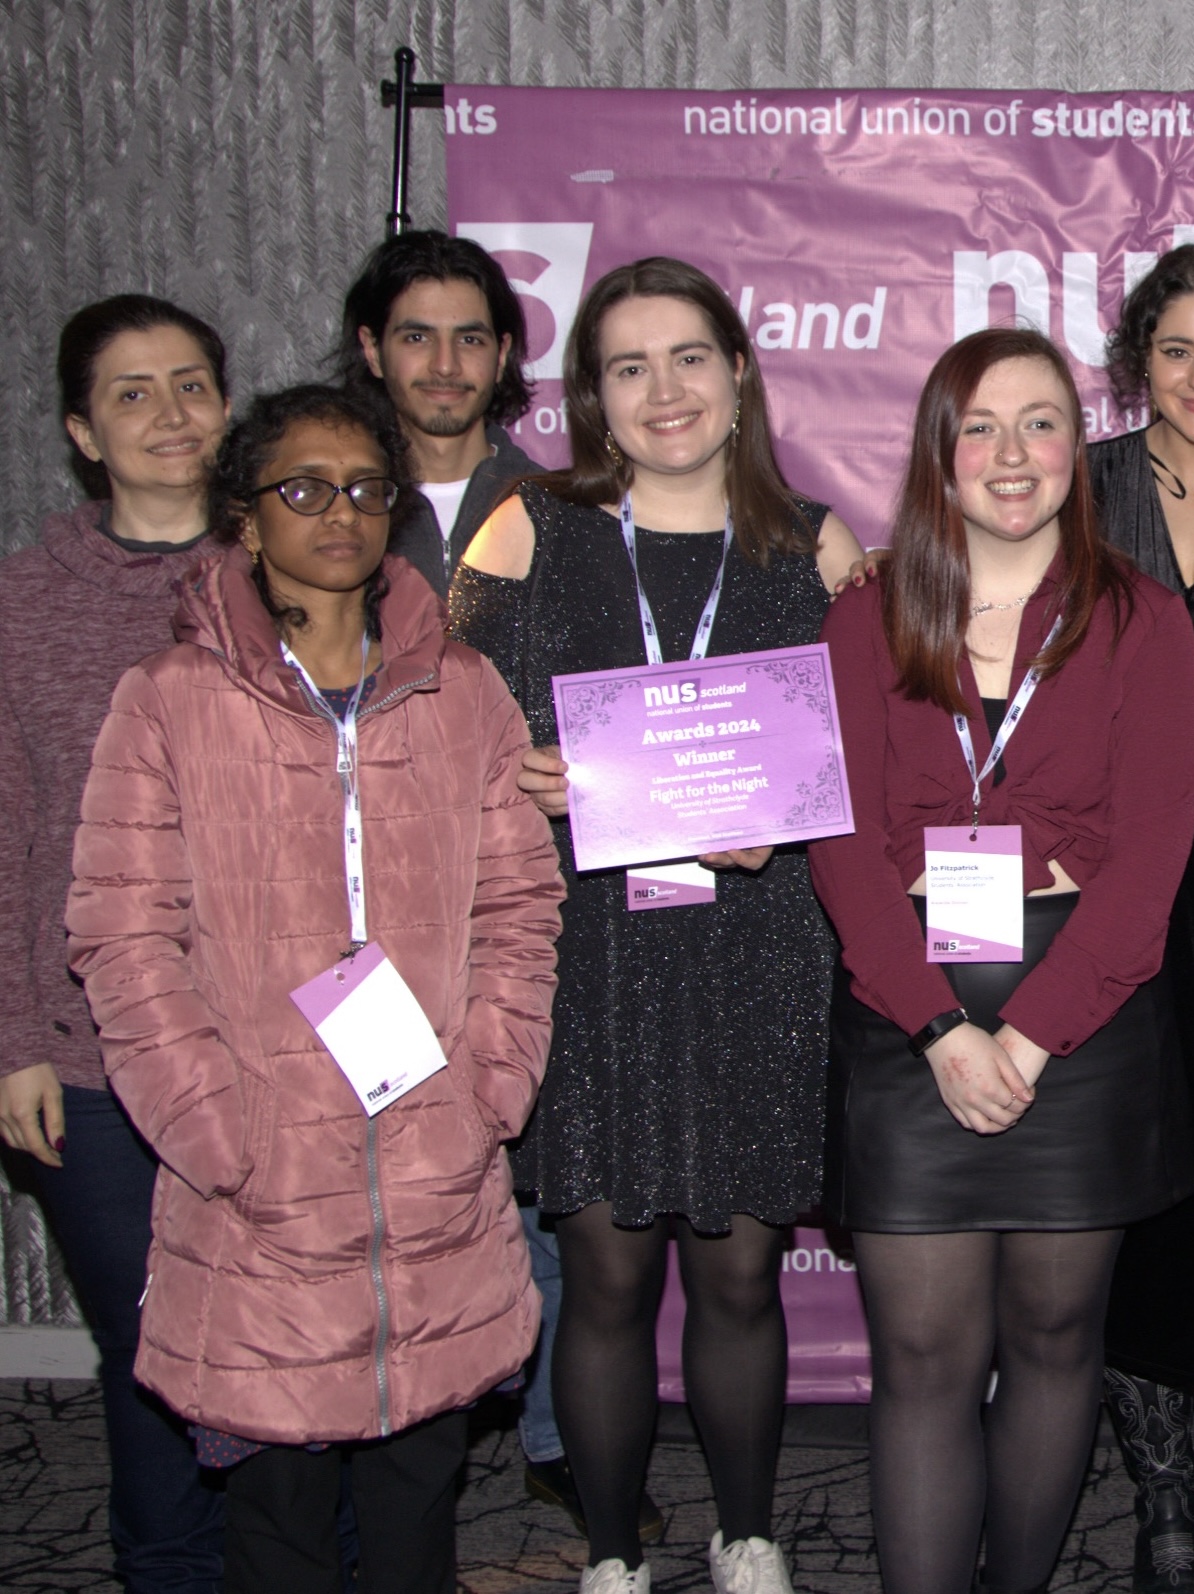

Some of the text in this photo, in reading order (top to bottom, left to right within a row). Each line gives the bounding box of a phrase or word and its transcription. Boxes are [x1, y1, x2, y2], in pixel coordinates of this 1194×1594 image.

[683, 97, 847, 135] national
[860, 98, 970, 136] union
[983, 99, 1023, 136] of
[644, 682, 746, 707] nus scotland
[646, 707, 673, 717] national
[674, 705, 693, 713] union
[701, 701, 733, 710] students
[641, 718, 761, 745] Awards 2024
[672, 749, 736, 767] Winner
[737, 763, 762, 774] Award
[649, 776, 769, 804] Fight for the Night
[634, 889, 656, 899] nus
[933, 942, 957, 951] nus
[366, 1081, 389, 1102] nus
